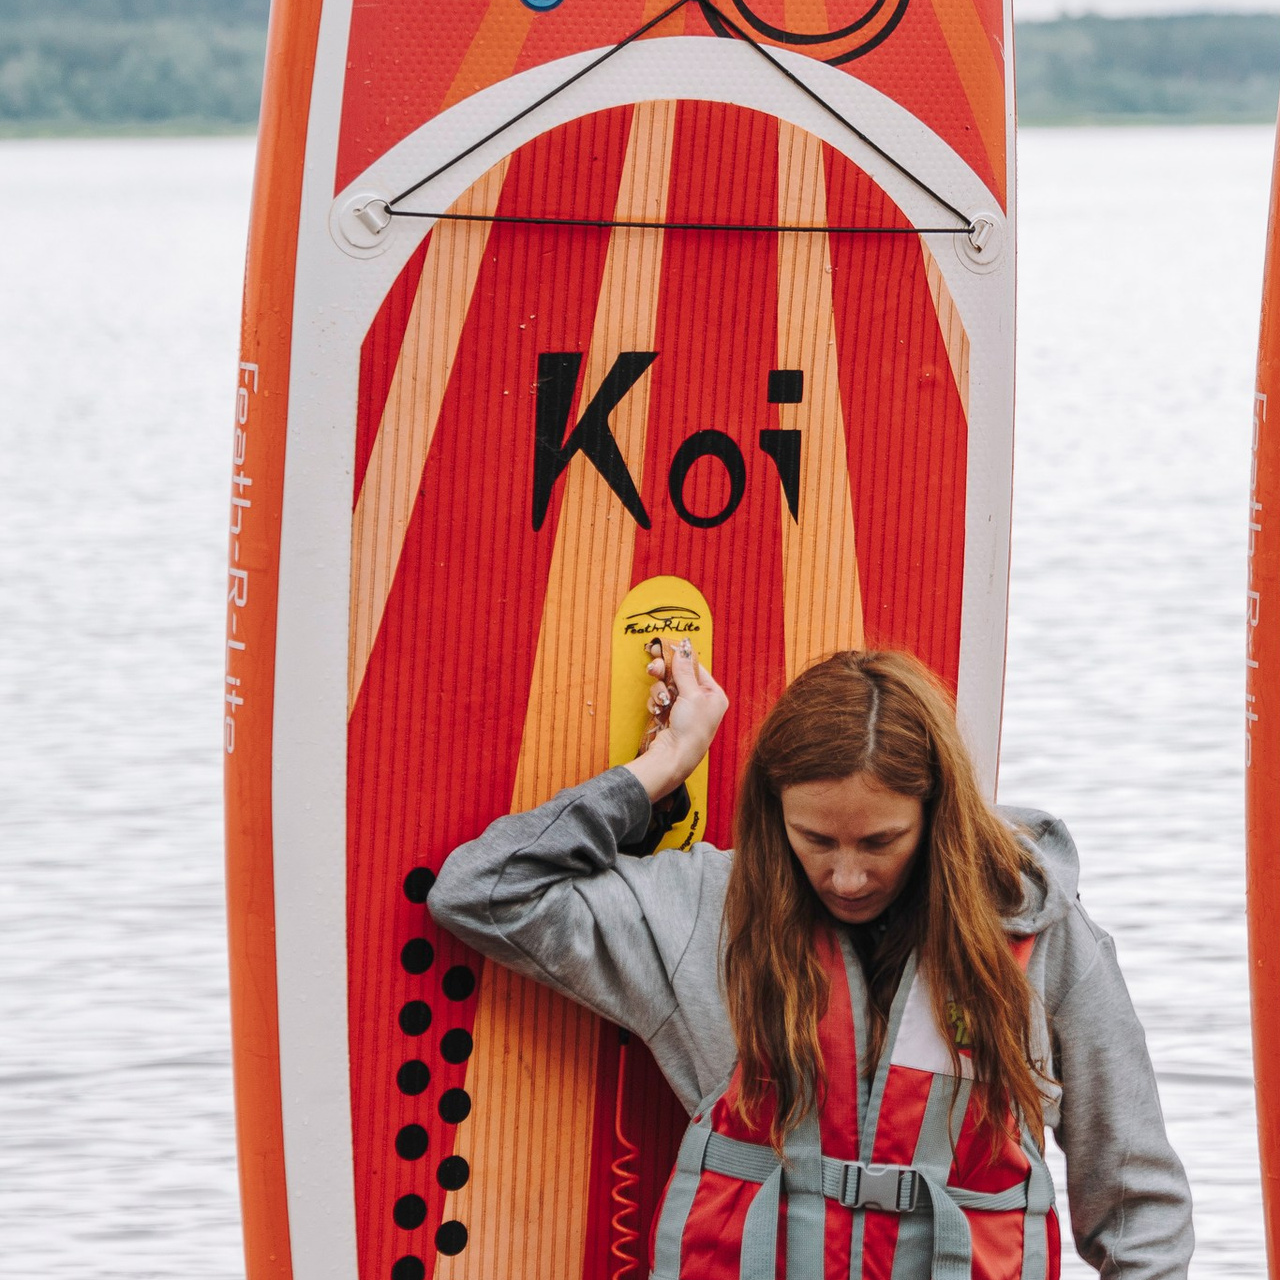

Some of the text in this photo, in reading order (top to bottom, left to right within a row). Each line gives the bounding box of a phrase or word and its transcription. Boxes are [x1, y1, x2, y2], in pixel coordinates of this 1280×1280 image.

[532, 351, 804, 532] Koi
[229, 362, 259, 754] Feath-R-Lite
[624, 618, 700, 635] Feath-R-Lite
